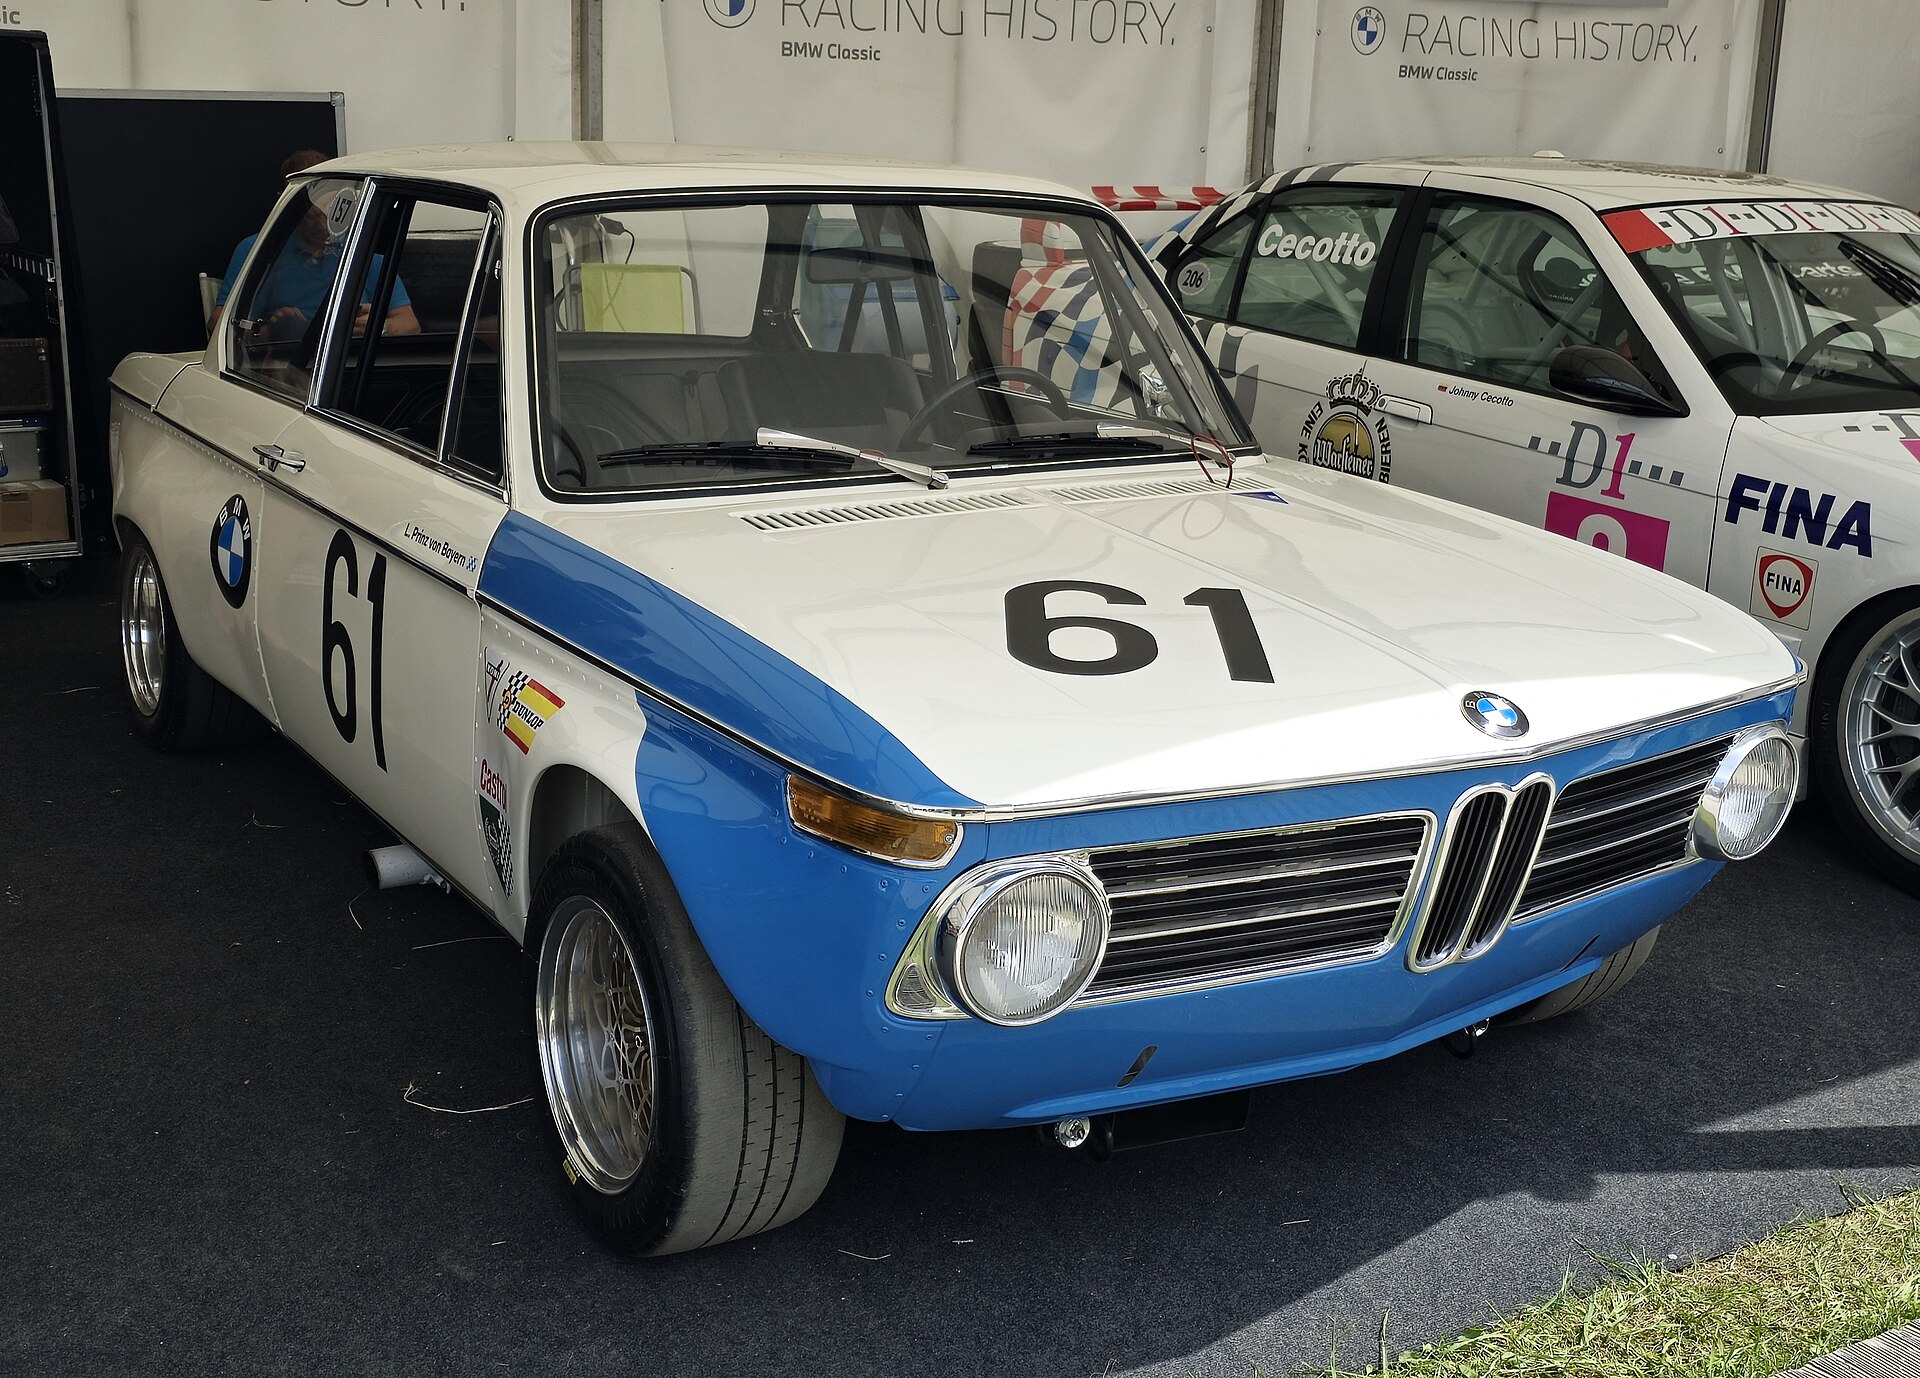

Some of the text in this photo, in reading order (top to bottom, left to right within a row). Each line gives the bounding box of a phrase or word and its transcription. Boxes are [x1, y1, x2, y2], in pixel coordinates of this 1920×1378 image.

[782, 0, 965, 36] RACING
[1402, 13, 1698, 63] RACING HISTORY.
[781, 41, 881, 61] BMW Classic
[1398, 64, 1478, 82] BMW Classic
[1257, 223, 1376, 268] Cecotto
[1181, 269, 1204, 288] 206
[1448, 385, 1514, 407] Johnny Cecotto
[1300, 400, 1324, 440] EINE
[1555, 420, 1635, 500] D1
[219, 497, 251, 541] BMW
[1724, 472, 1873, 558] FINA
[411, 526, 429, 546] Prinz
[429, 538, 441, 554] von
[441, 541, 466, 567] Bayern
[1766, 571, 1801, 596] FINA
[321, 528, 389, 774] 61
[1004, 579, 1275, 684] 61
[512, 700, 545, 730] DUNLOP
